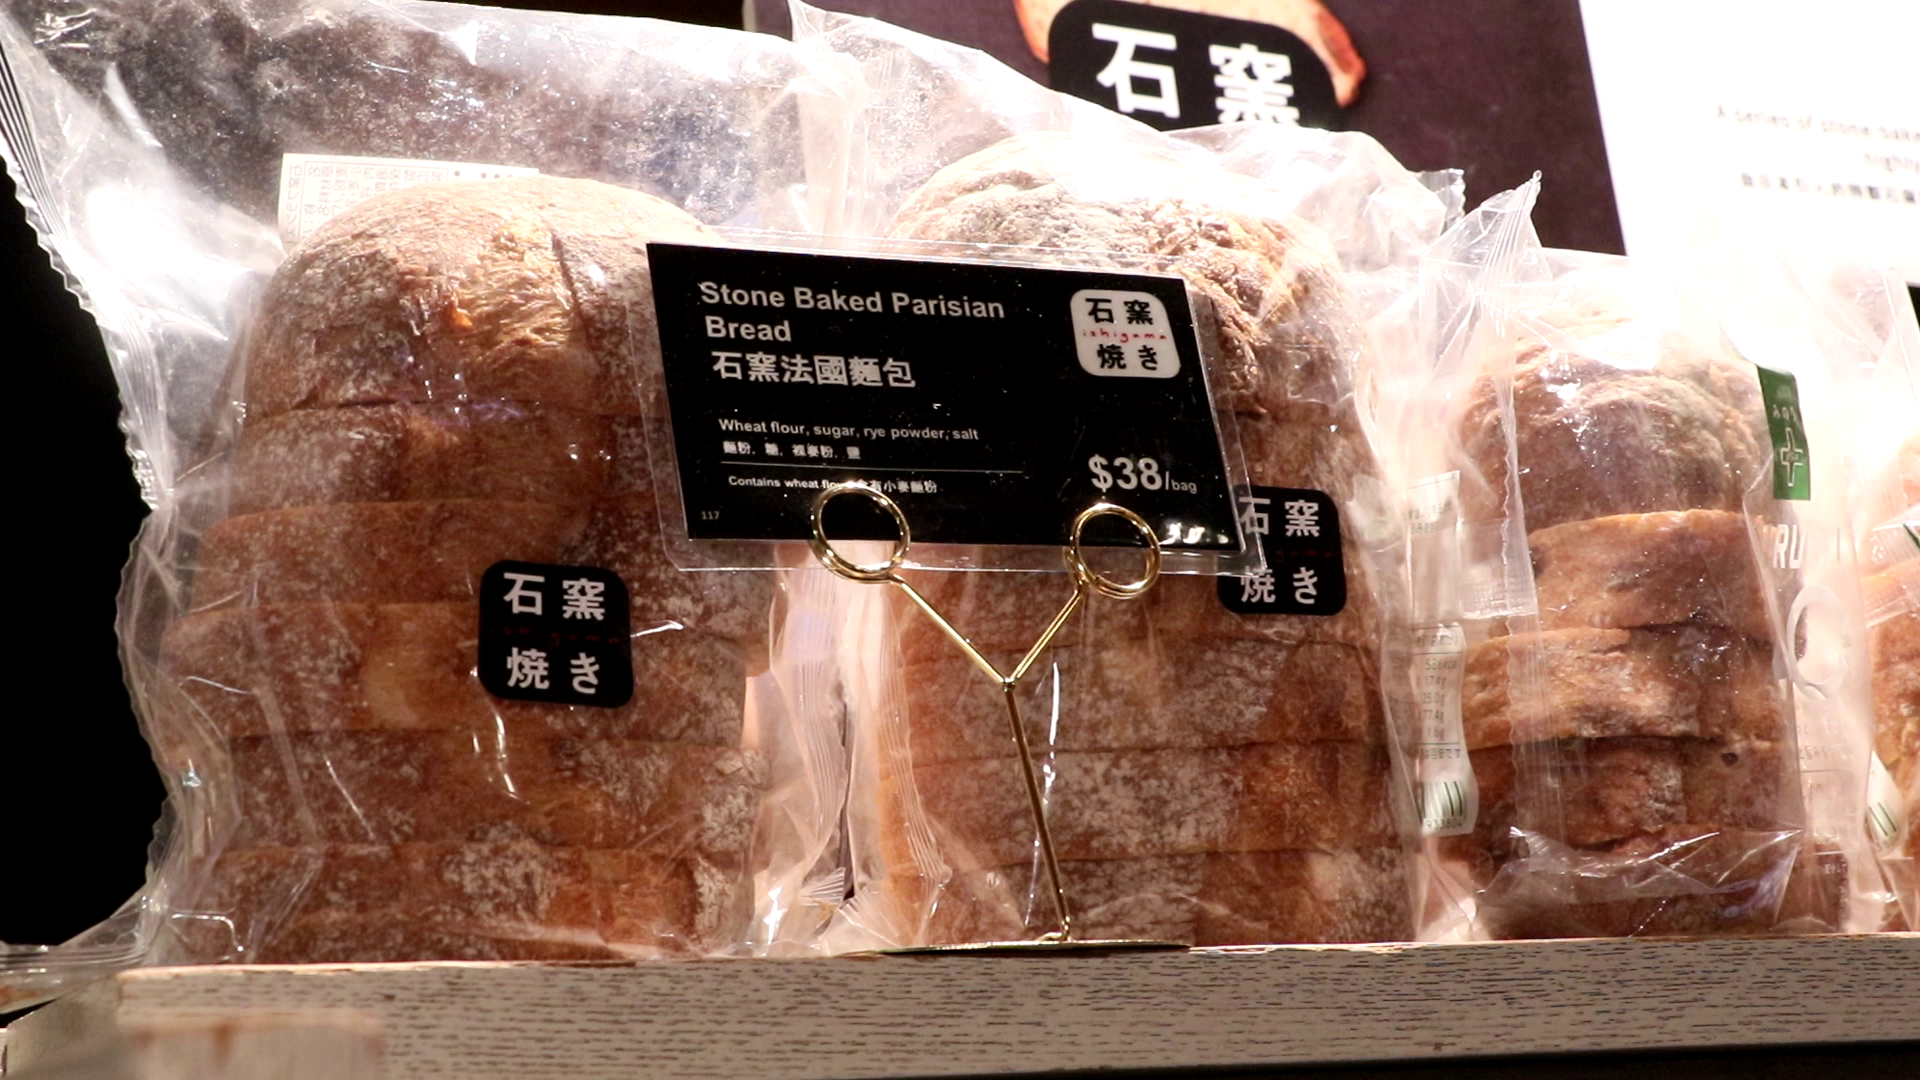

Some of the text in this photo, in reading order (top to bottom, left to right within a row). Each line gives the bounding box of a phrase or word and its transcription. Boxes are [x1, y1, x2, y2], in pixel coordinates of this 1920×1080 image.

[700, 281, 1005, 319] Stone Baked Parisian
[1085, 298, 1154, 326] 石窯
[706, 315, 791, 343] Bread
[711, 350, 916, 388] 石窯法國麵包
[1097, 344, 1158, 371] 焼き
[718, 419, 767, 434] Wheat
[770, 420, 810, 435] flour,
[813, 424, 860, 439] sugar,
[864, 427, 886, 439] rye
[953, 429, 980, 441] salt
[728, 476, 781, 488] Contains
[784, 480, 819, 489] wheat
[701, 510, 720, 520] 117
[1238, 496, 1320, 538] 石窯
[503, 572, 606, 621] 石窯
[1240, 565, 1318, 605] 焼き
[506, 647, 600, 695] 焼き
